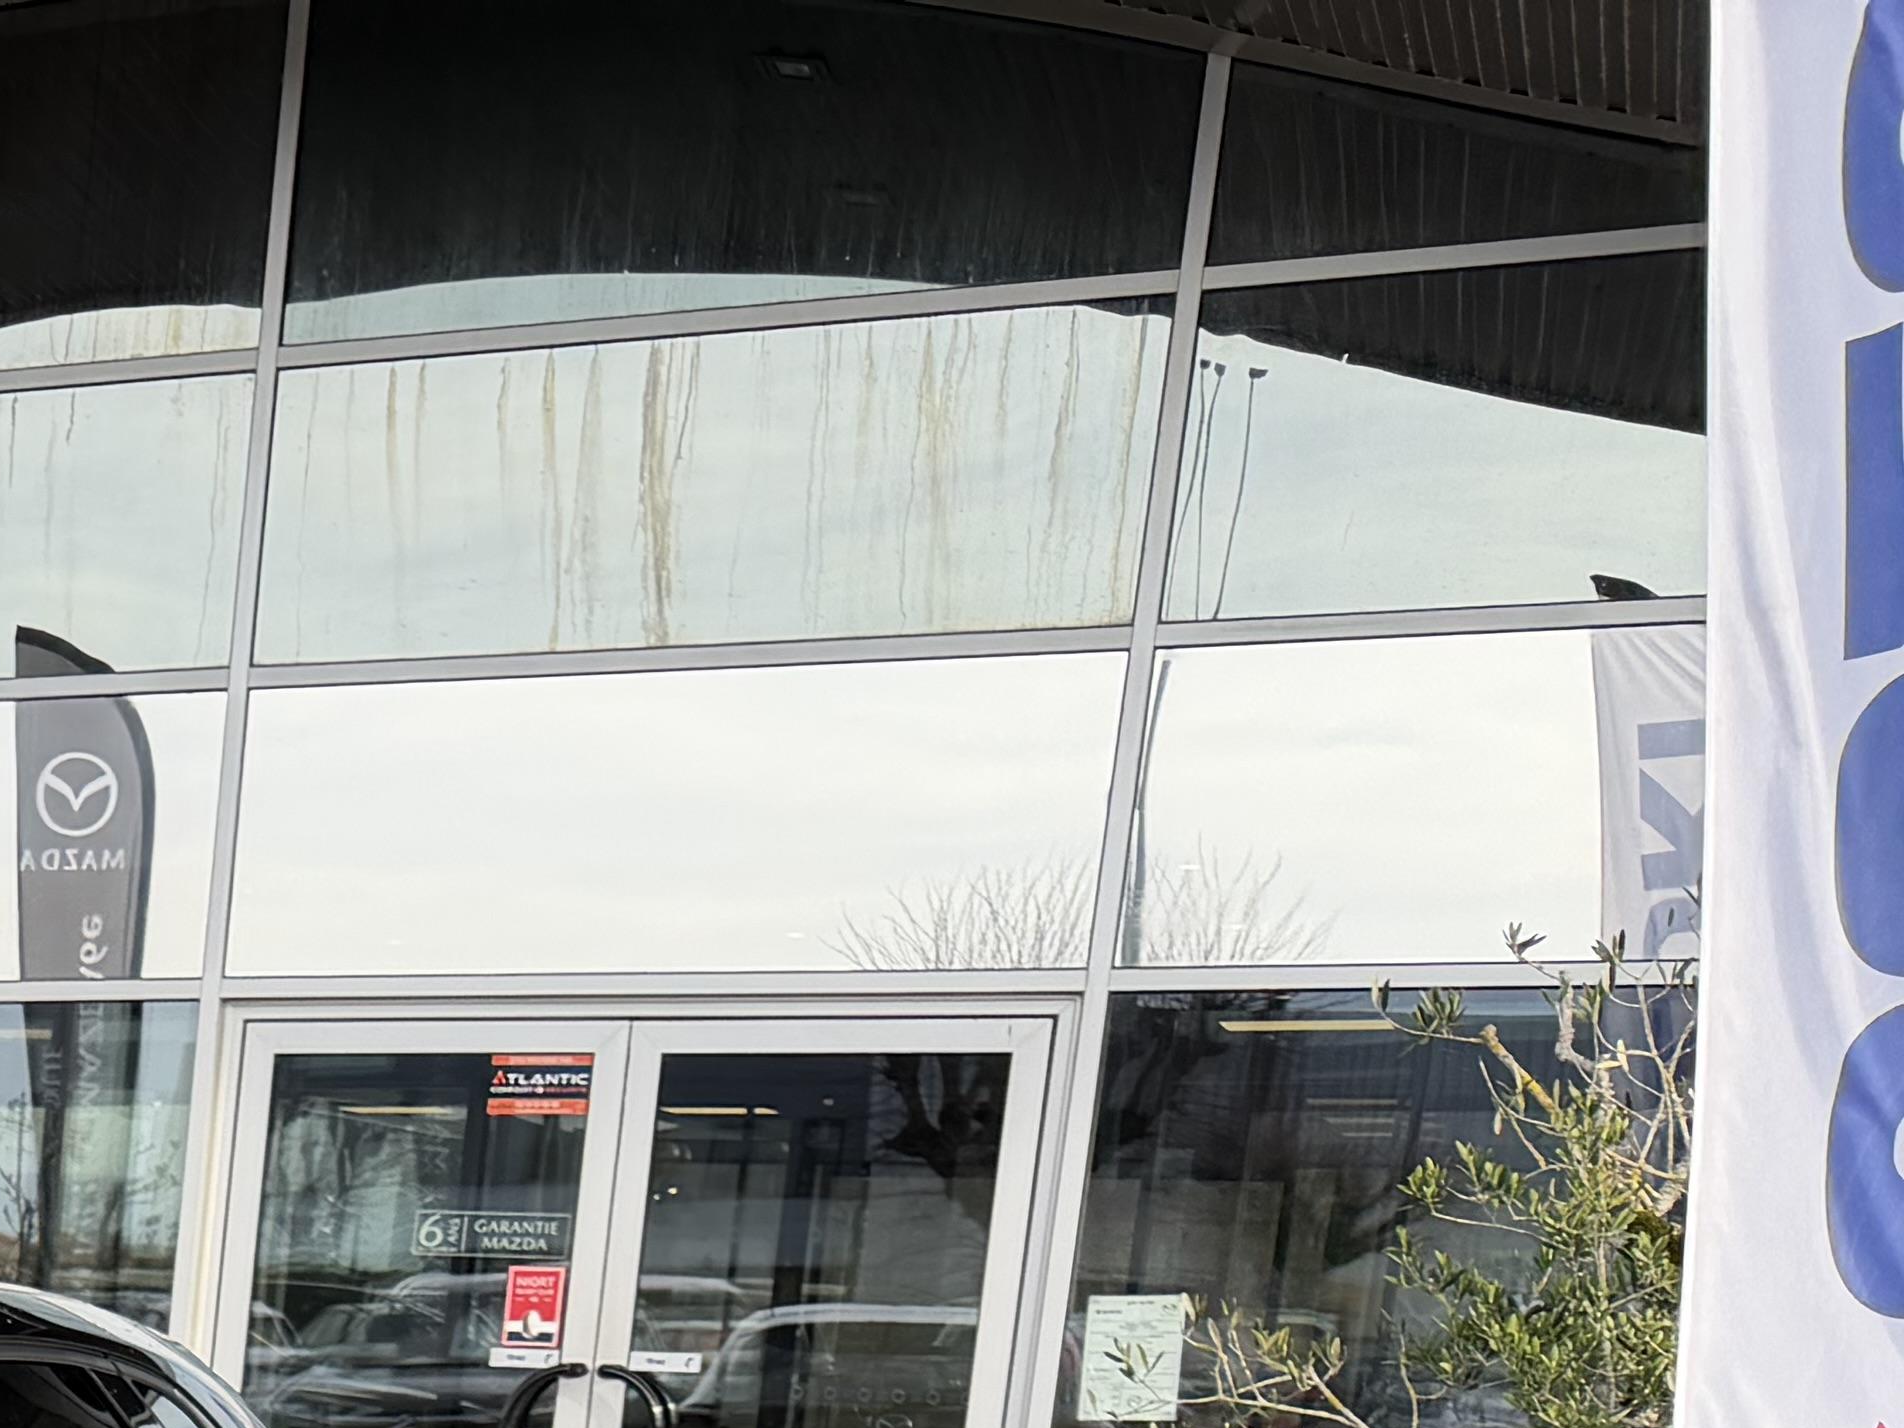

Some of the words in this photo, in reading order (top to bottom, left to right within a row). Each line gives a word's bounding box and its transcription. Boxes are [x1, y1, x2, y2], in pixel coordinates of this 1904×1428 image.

[491, 1070, 590, 1086] ATLANTIC
[418, 1211, 443, 1248] 6
[473, 1218, 559, 1236] GARANTIE
[480, 1236, 548, 1251] MAZDA
